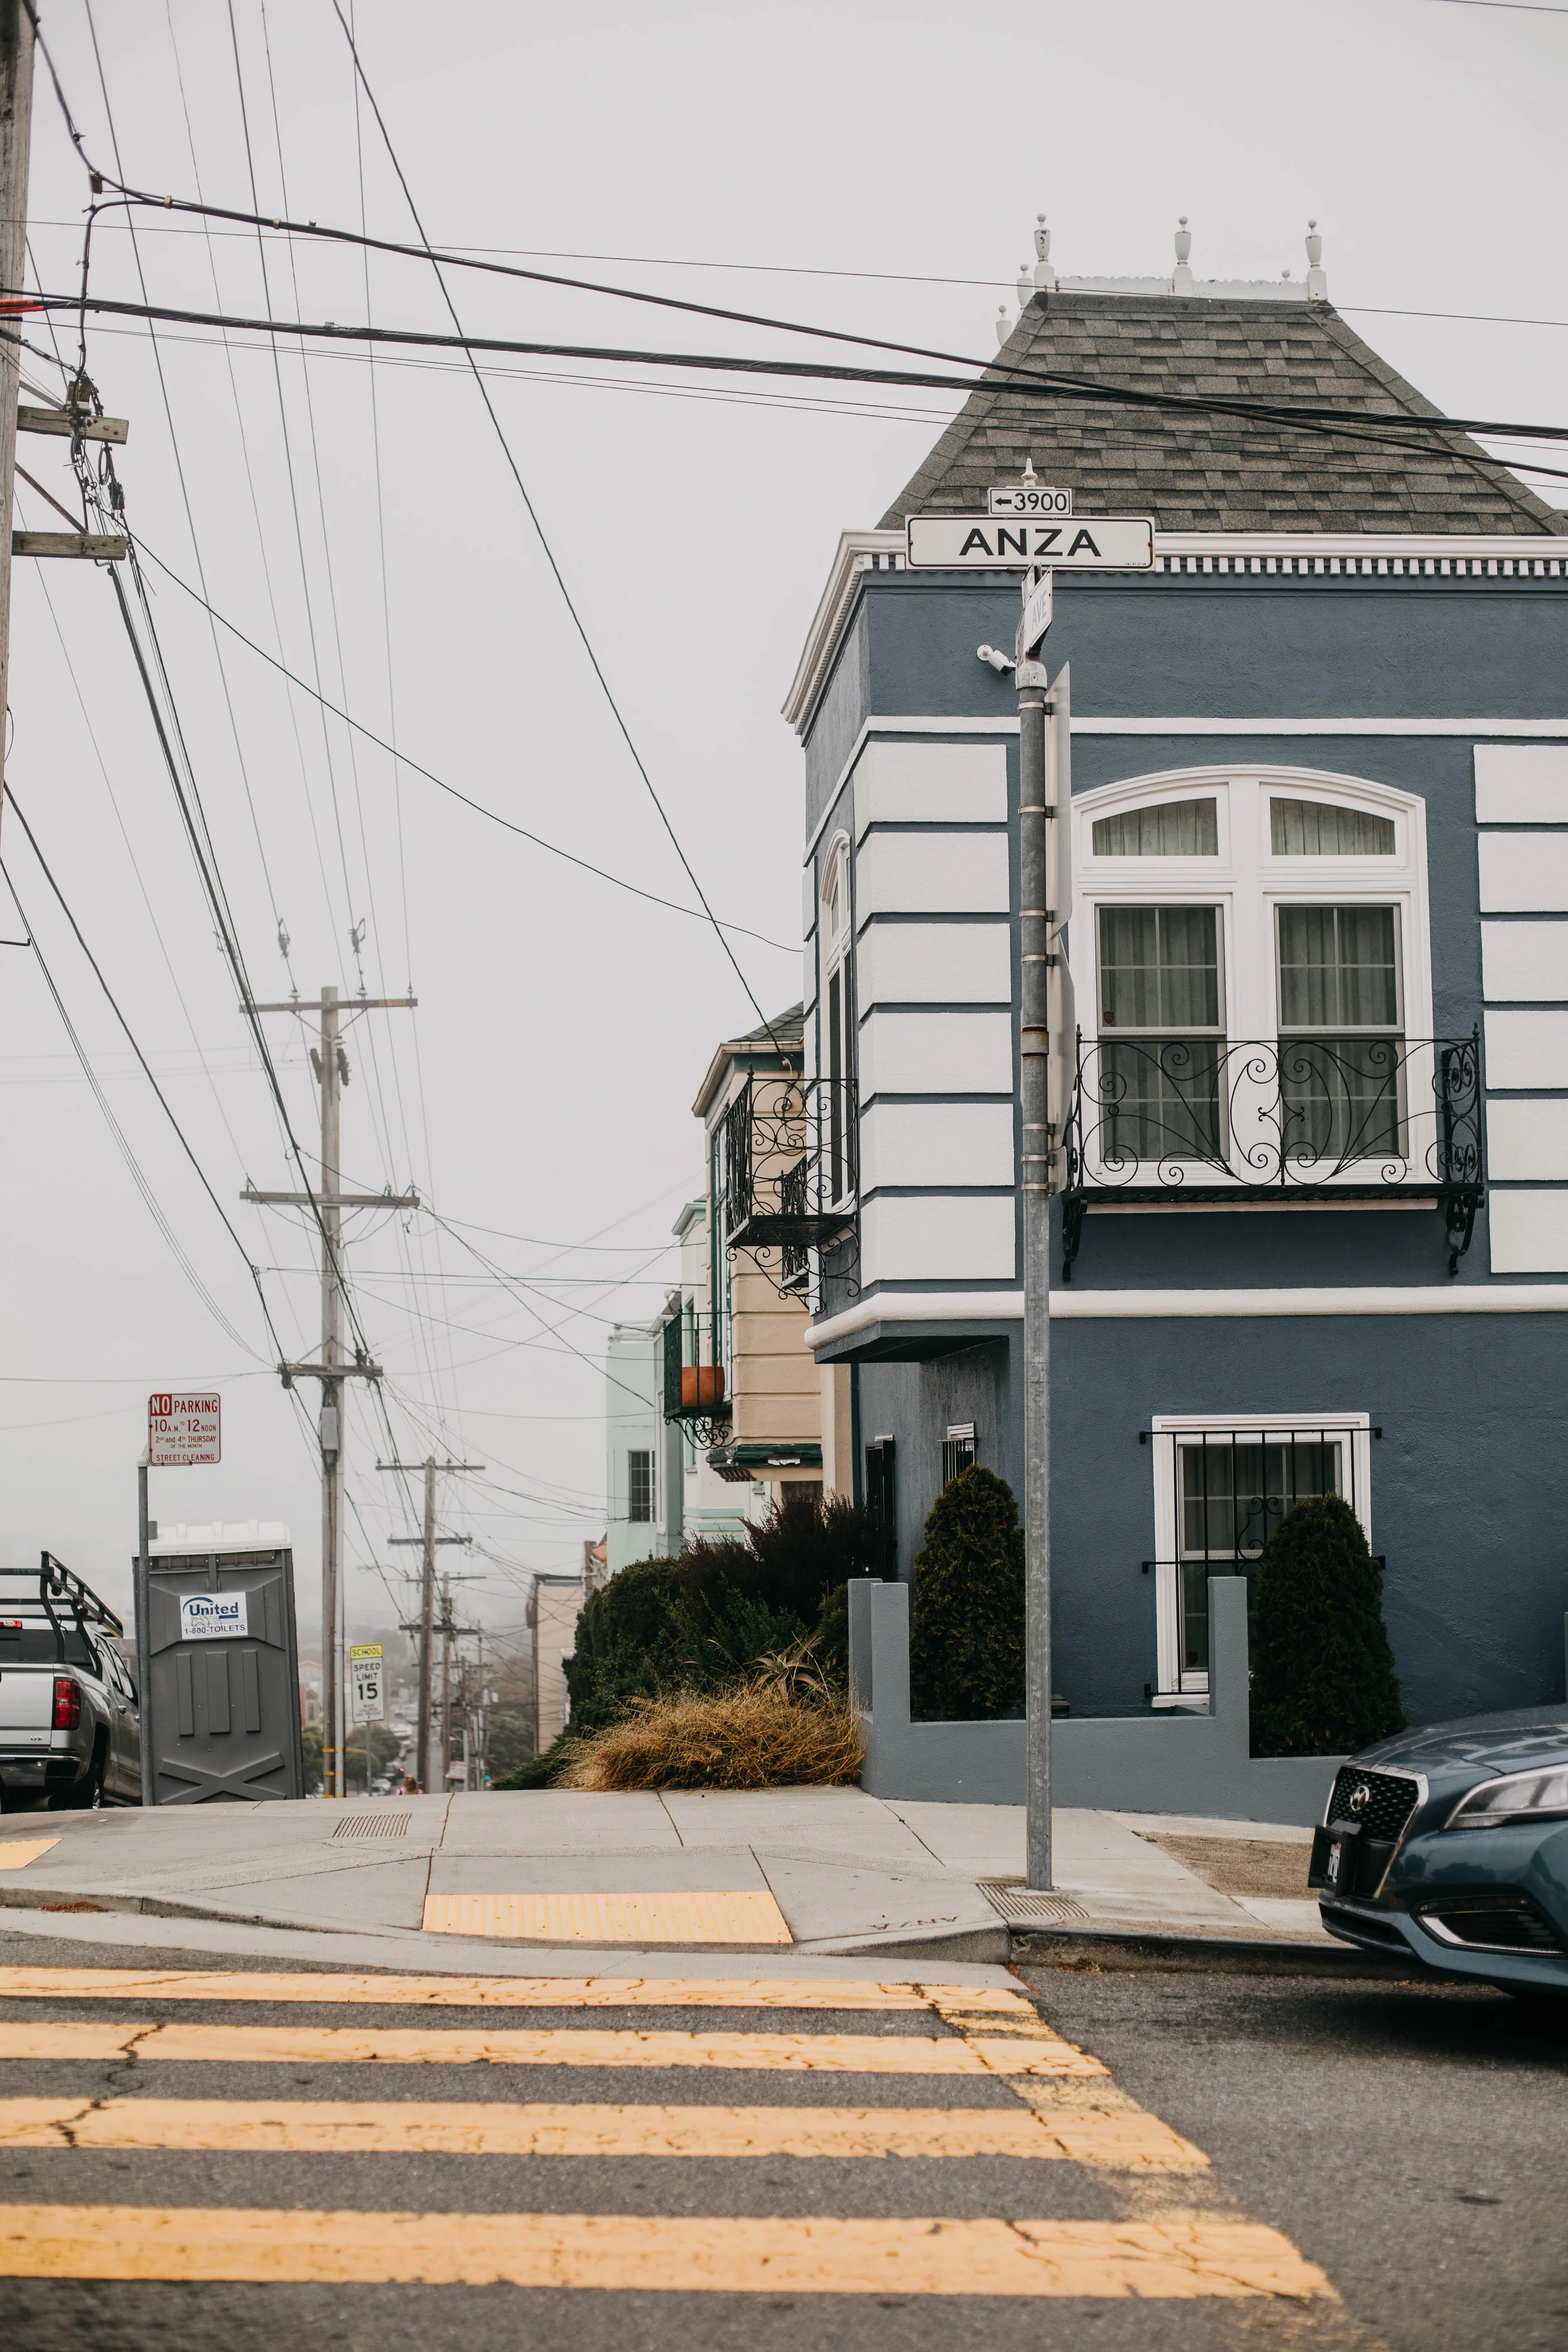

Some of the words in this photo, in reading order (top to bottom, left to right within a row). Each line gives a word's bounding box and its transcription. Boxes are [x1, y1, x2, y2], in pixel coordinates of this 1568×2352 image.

[1014, 492, 1067, 511] 3900
[958, 528, 1102, 557] ANZA
[1031, 590, 1047, 633] AVE
[152, 1396, 170, 1414] NO
[174, 1399, 218, 1413] PARKING
[154, 1419, 167, 1432] 10
[188, 1419, 200, 1432] 12
[183, 1453, 215, 1461] CLEANING
[189, 1602, 238, 1616] United
[184, 1624, 245, 1634] 1-800-TOILETS
[352, 1647, 381, 1656] SCHOOL
[354, 1663, 381, 1671] SPEED
[356, 1673, 378, 1681] LIMIT
[358, 1682, 378, 1700] 15
